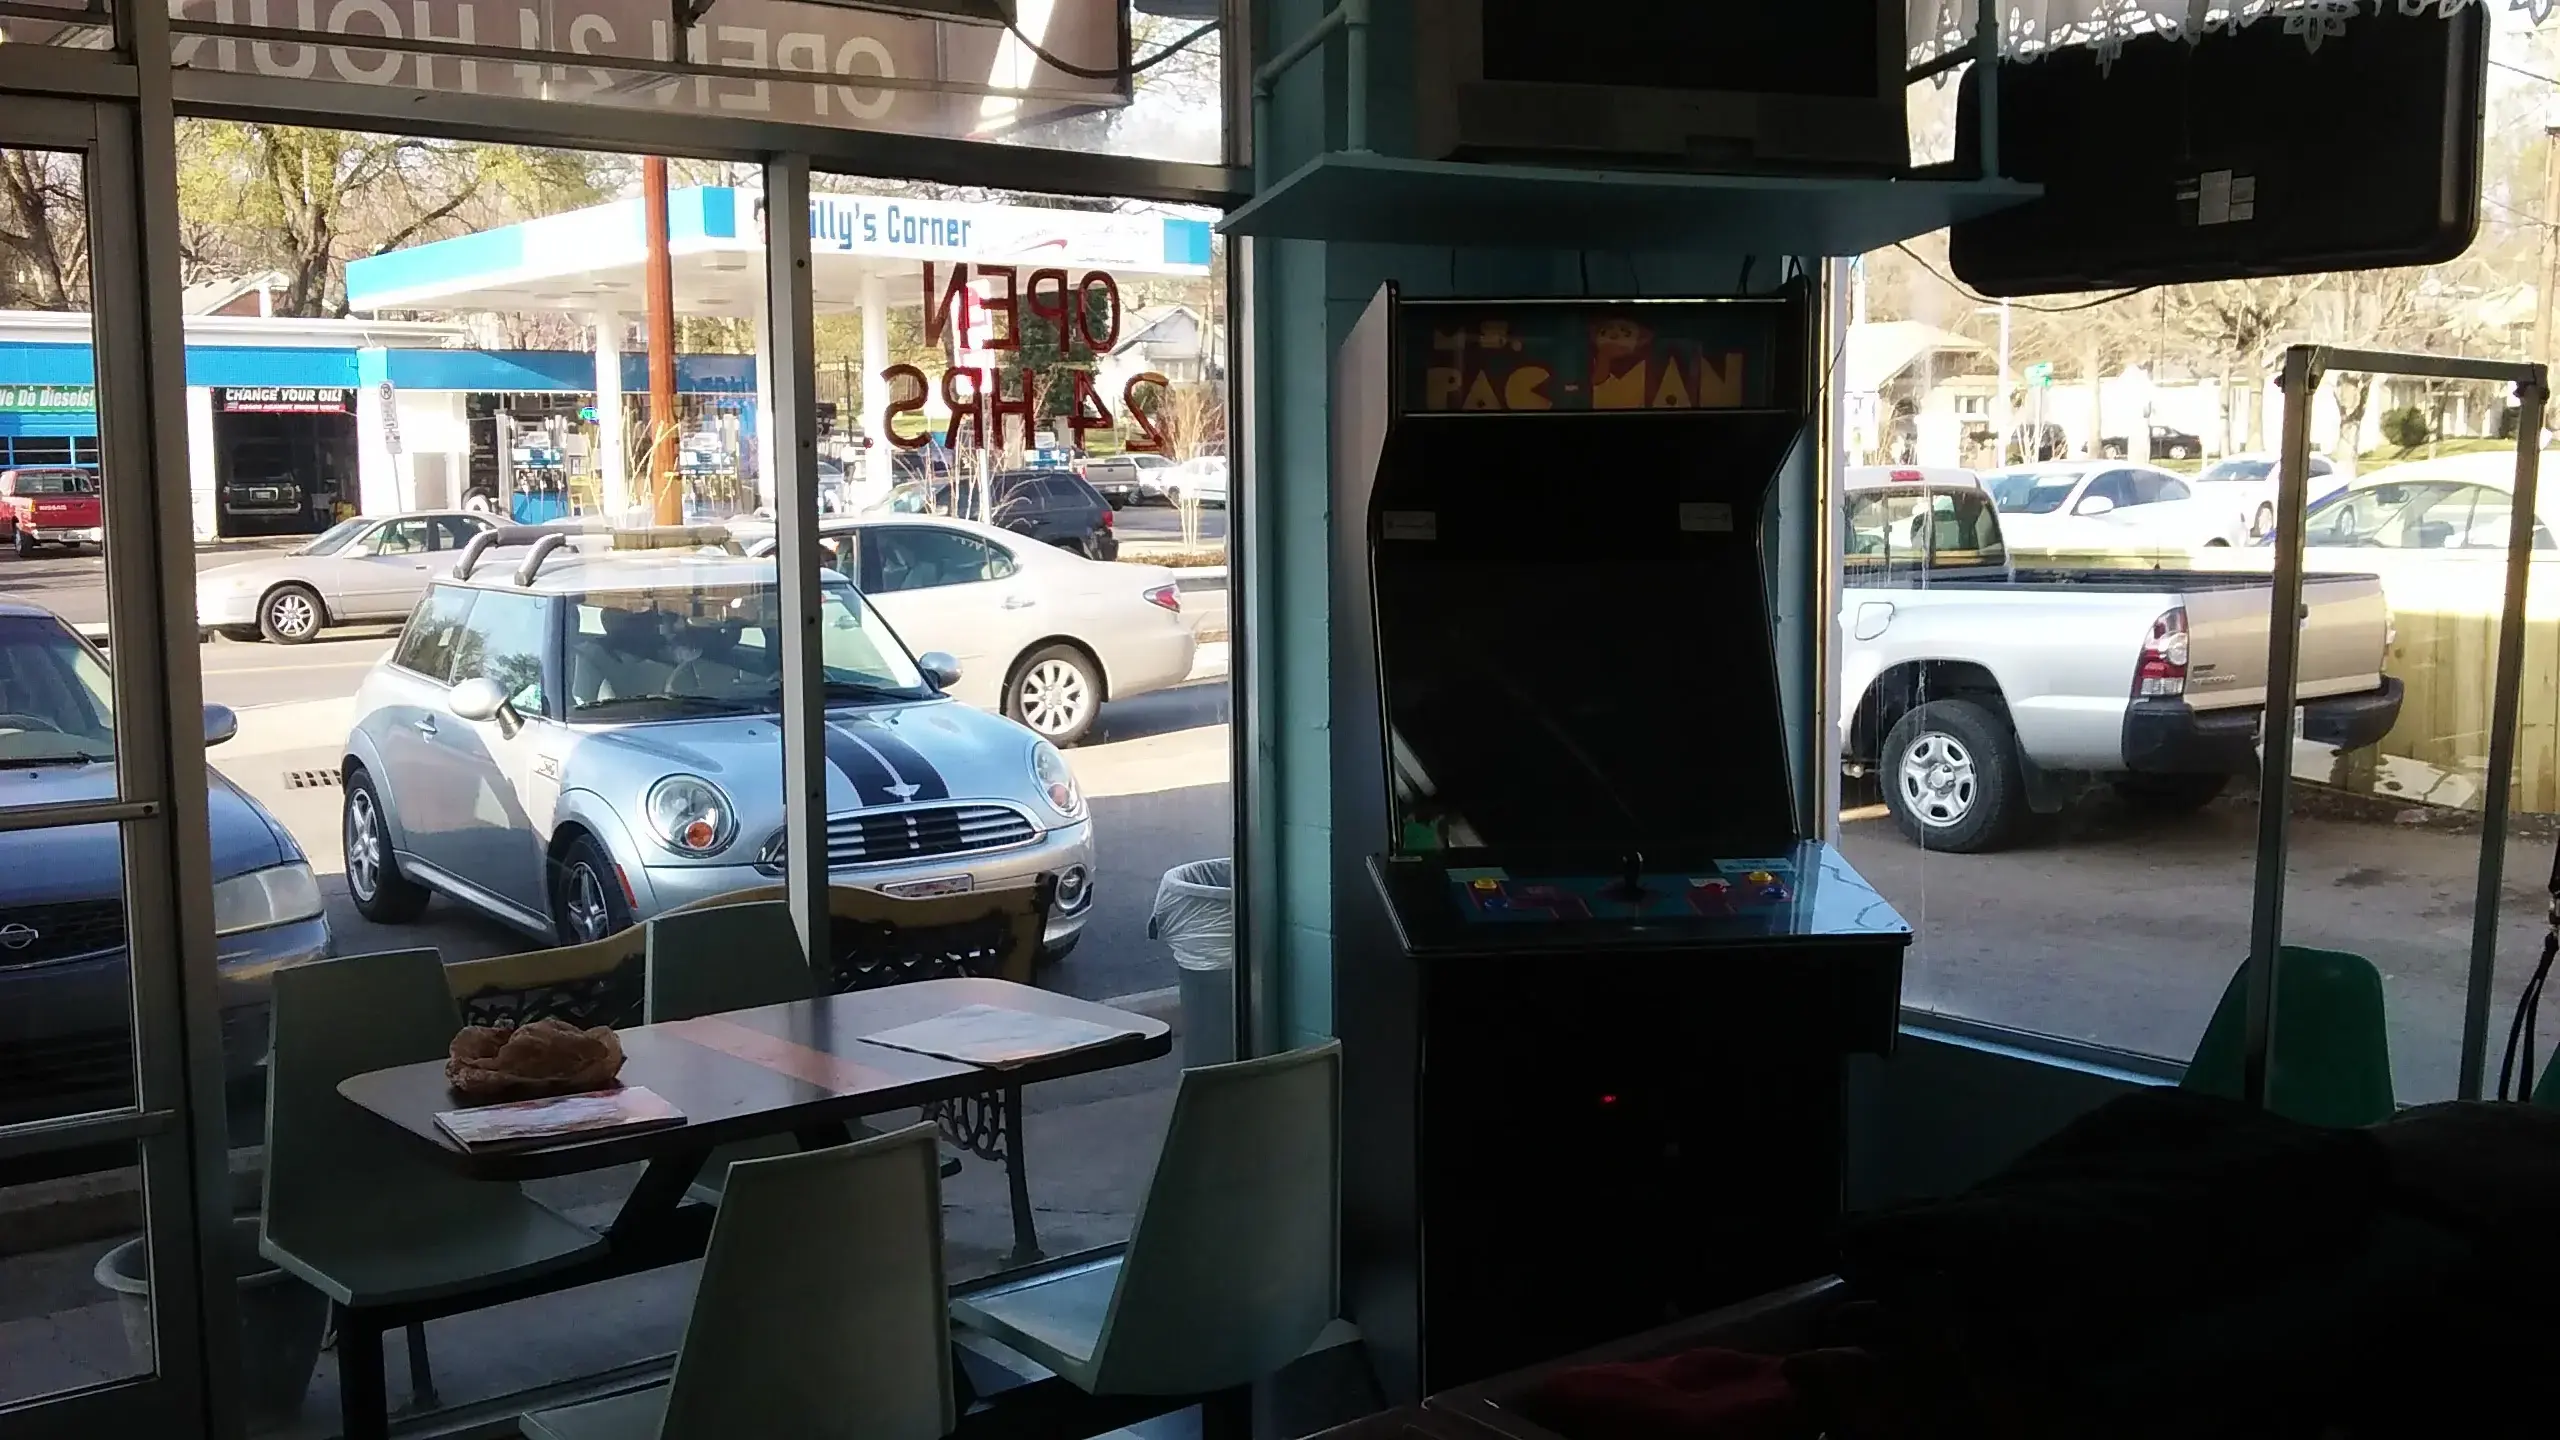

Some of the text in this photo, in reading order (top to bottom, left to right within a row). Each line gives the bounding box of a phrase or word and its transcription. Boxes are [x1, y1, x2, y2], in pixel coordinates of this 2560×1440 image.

[809, 199, 876, 250] illy's
[887, 205, 972, 248] Corner
[17, 389, 37, 407] Do
[40, 389, 95, 407] Diesels!
[225, 387, 343, 403] CHANGE YOUR OIL!
